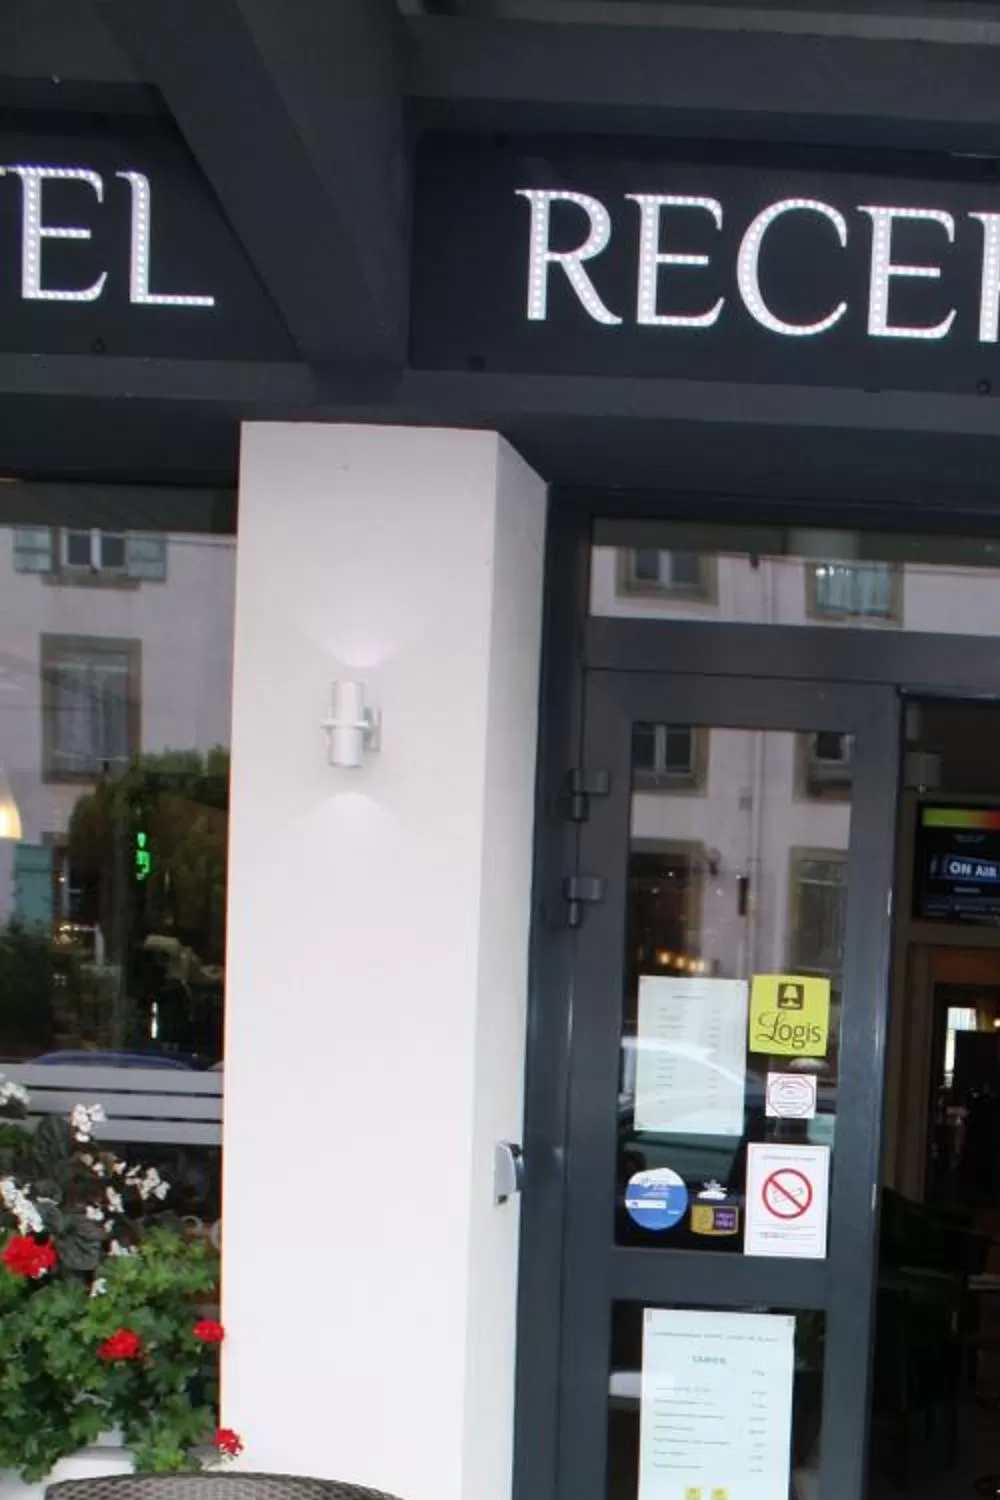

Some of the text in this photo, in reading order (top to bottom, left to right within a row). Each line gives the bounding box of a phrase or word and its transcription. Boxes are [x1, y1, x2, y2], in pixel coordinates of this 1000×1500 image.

[0, 165, 215, 306] EL
[949, 861, 997, 877] ON AIR
[755, 1010, 822, 1049] Logis
